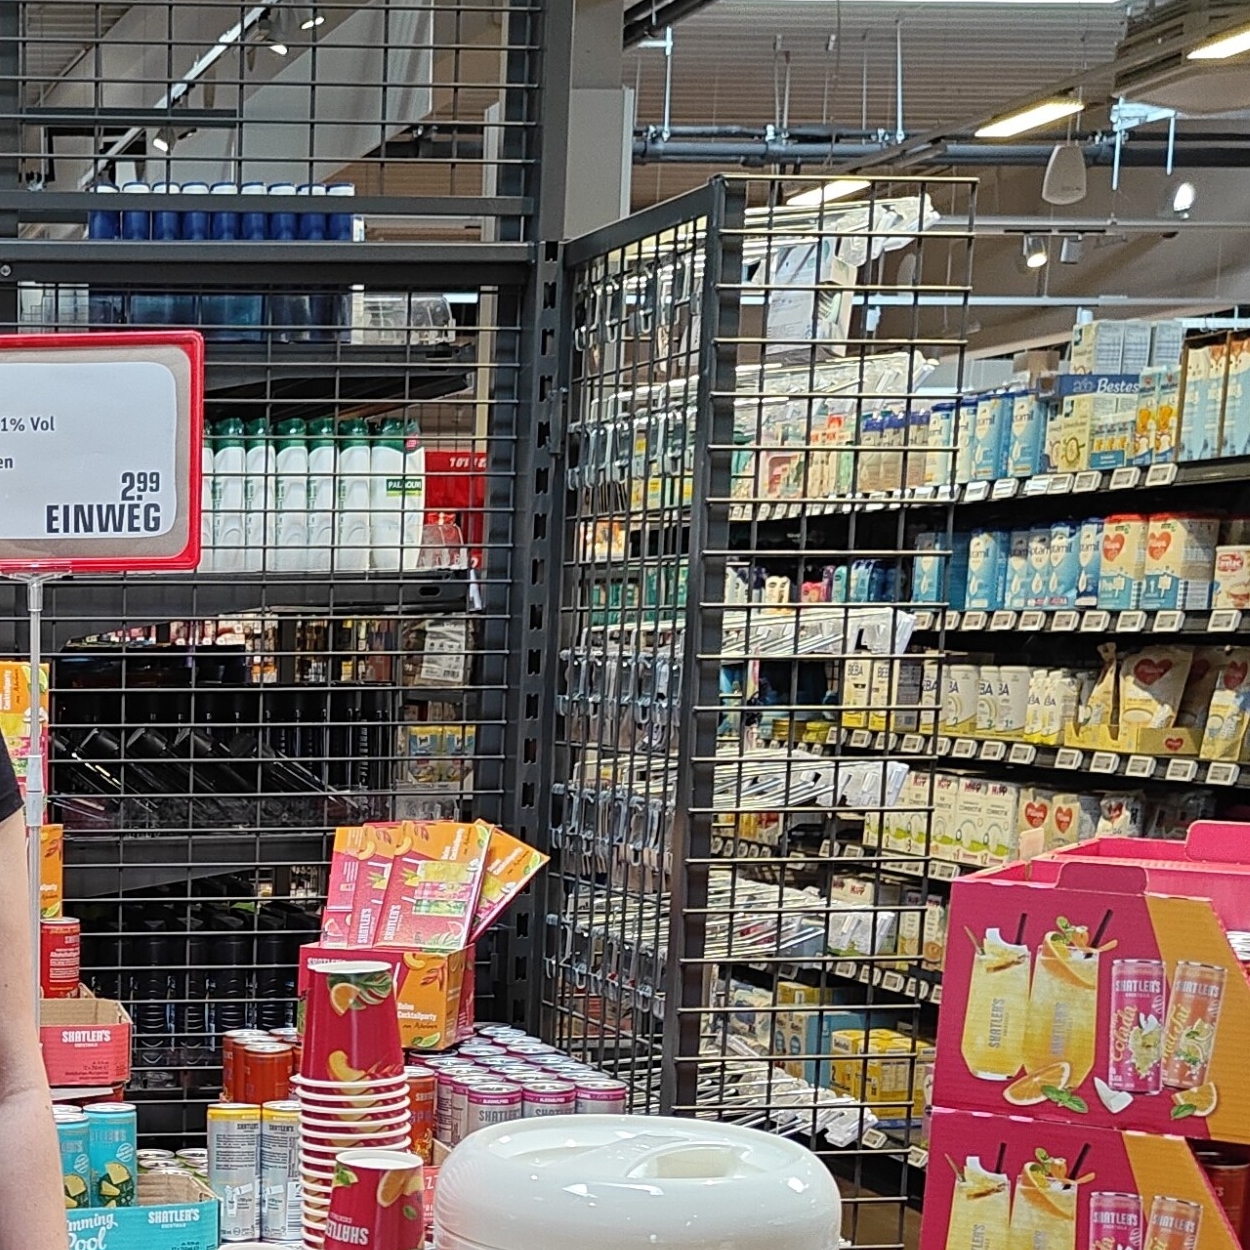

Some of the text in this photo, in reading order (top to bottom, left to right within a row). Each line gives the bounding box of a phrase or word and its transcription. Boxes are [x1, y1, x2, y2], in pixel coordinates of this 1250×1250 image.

[30, 415, 56, 432] Vol
[121, 471, 161, 501] 2.99
[46, 503, 162, 534] EINWEG
[61, 1029, 112, 1044] SHATLER'S
[67, 1213, 119, 1233] mming
[147, 1208, 200, 1224] SHATLER'S
